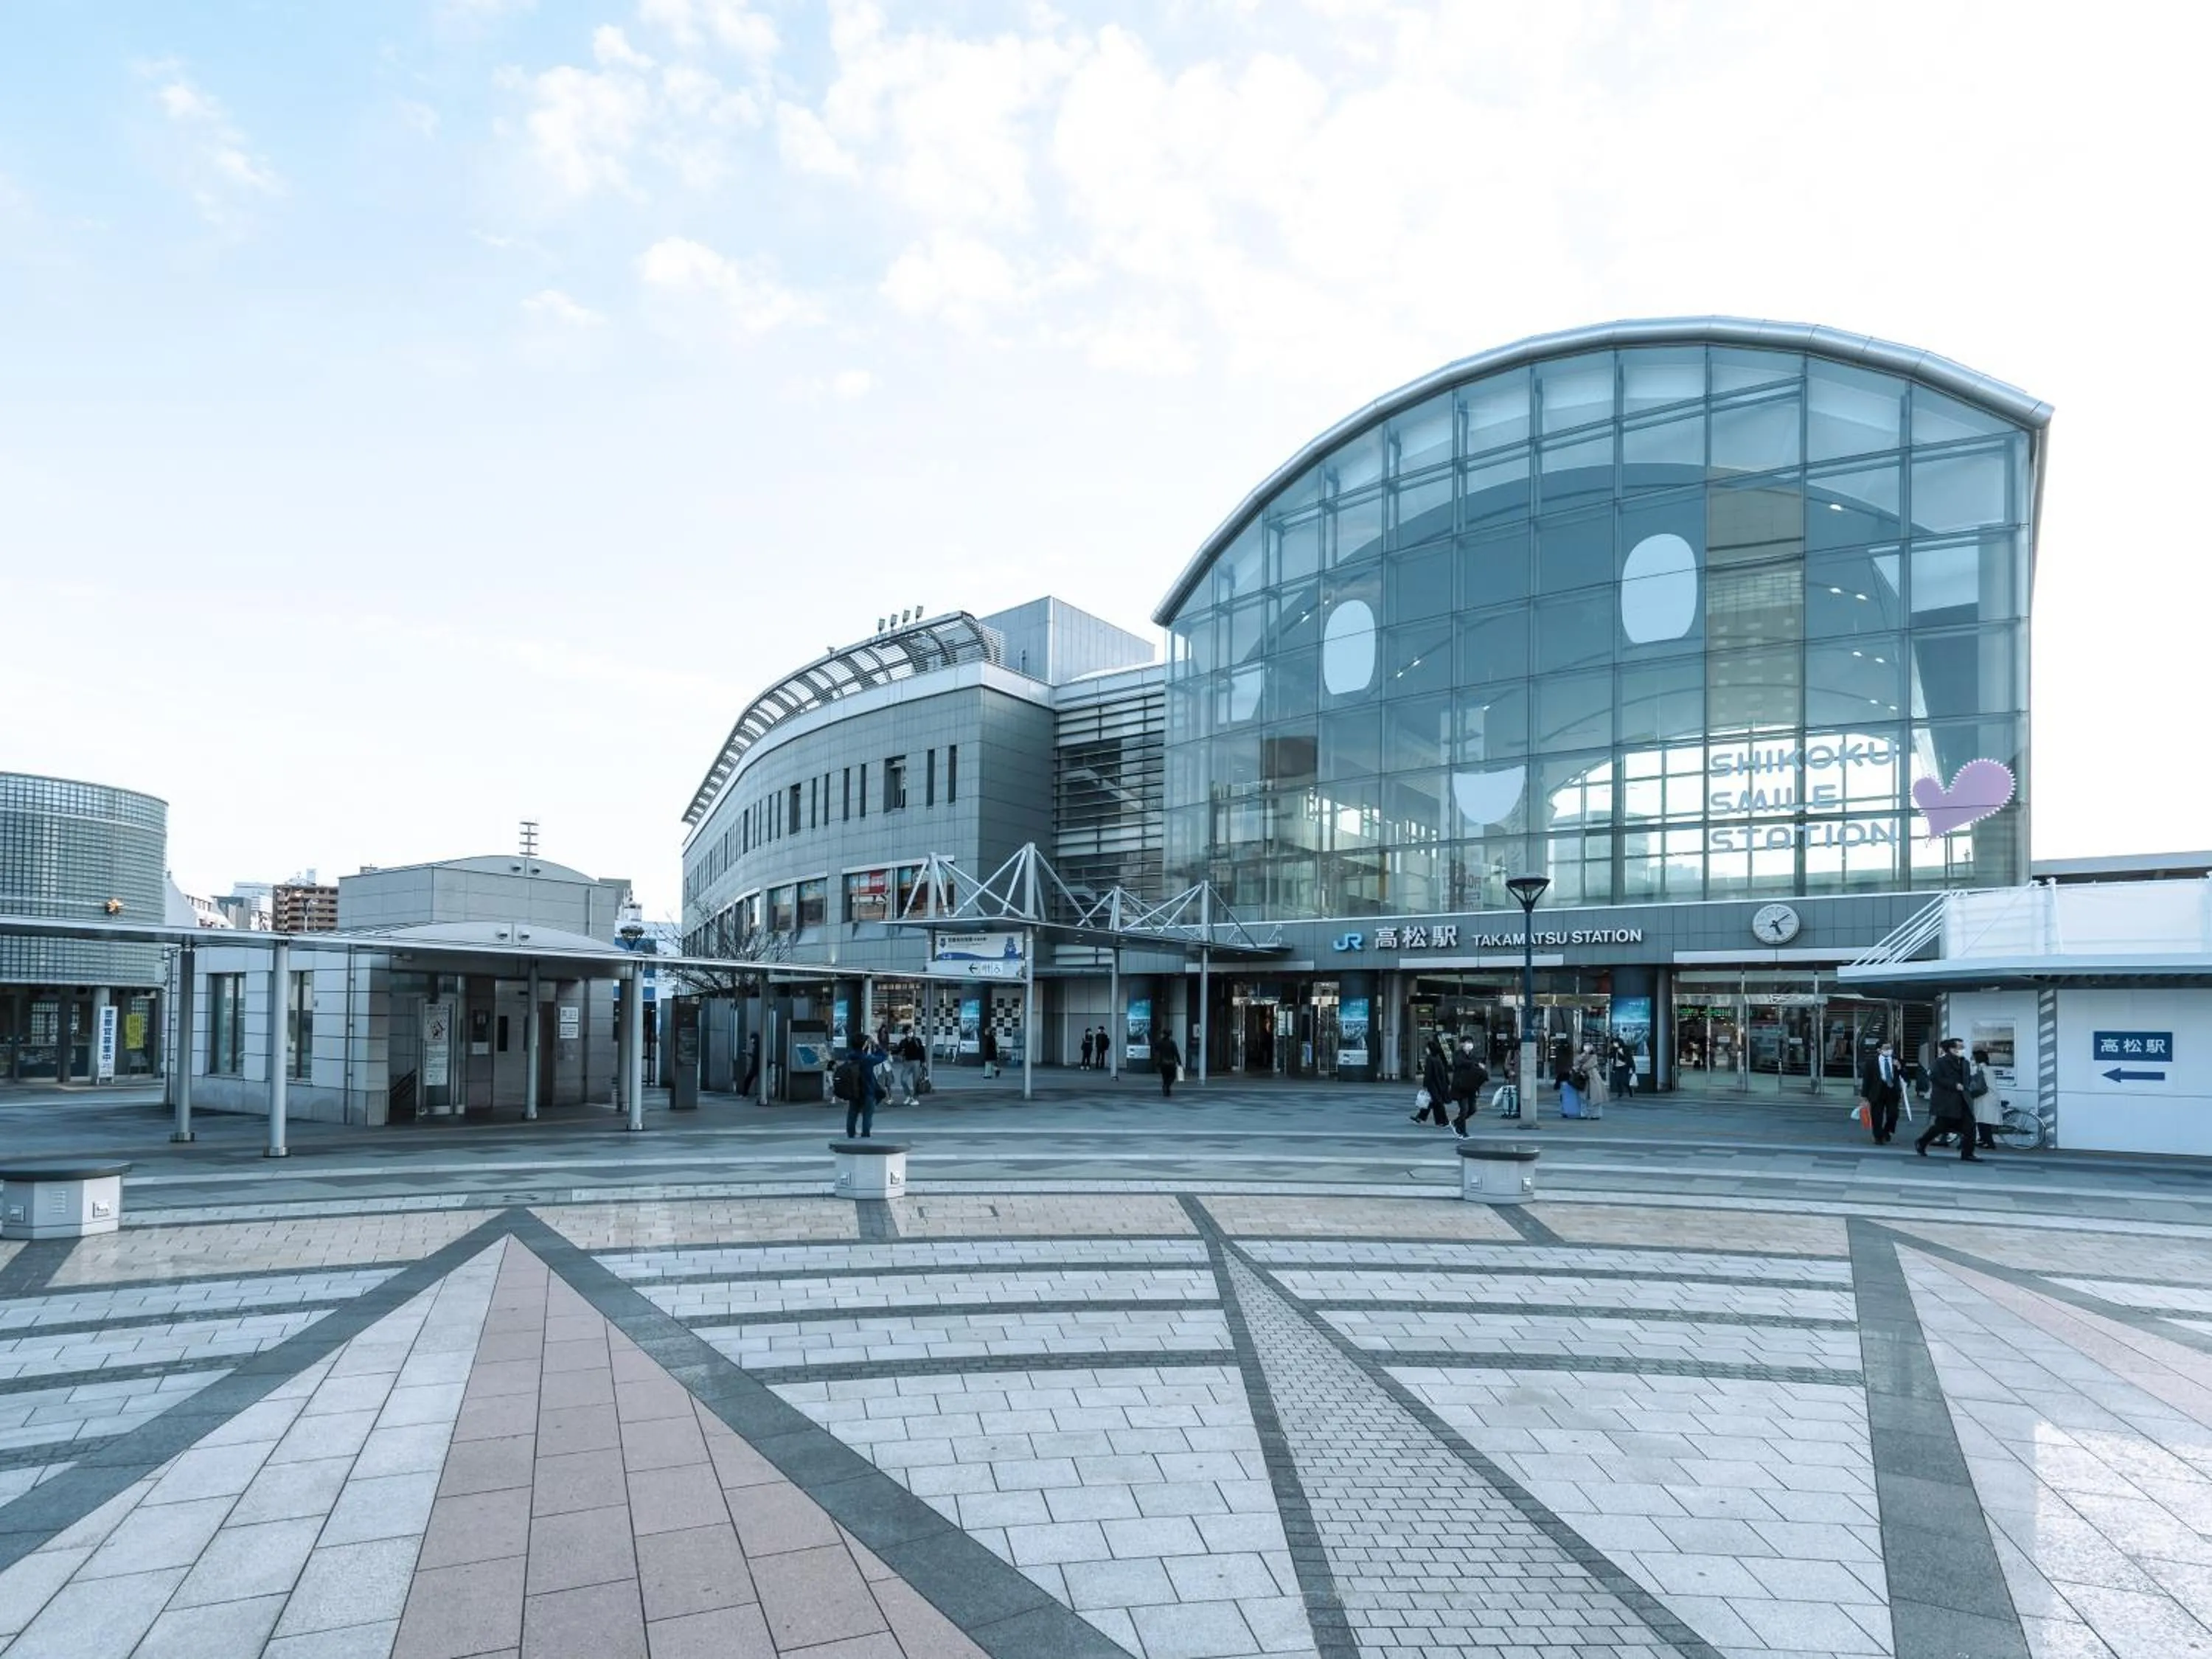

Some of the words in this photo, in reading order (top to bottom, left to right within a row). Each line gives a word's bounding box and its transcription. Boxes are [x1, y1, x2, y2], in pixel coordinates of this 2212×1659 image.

[1710, 740, 1895, 777] SHIKOKU
[1710, 784, 1837, 815] SMILE
[1710, 821, 1897, 852] STATION
[1333, 933, 1363, 950] JR
[1374, 925, 1458, 949] 高松駅
[1571, 929, 1643, 944] STATION
[2100, 1038, 2165, 1053] 高松駅
